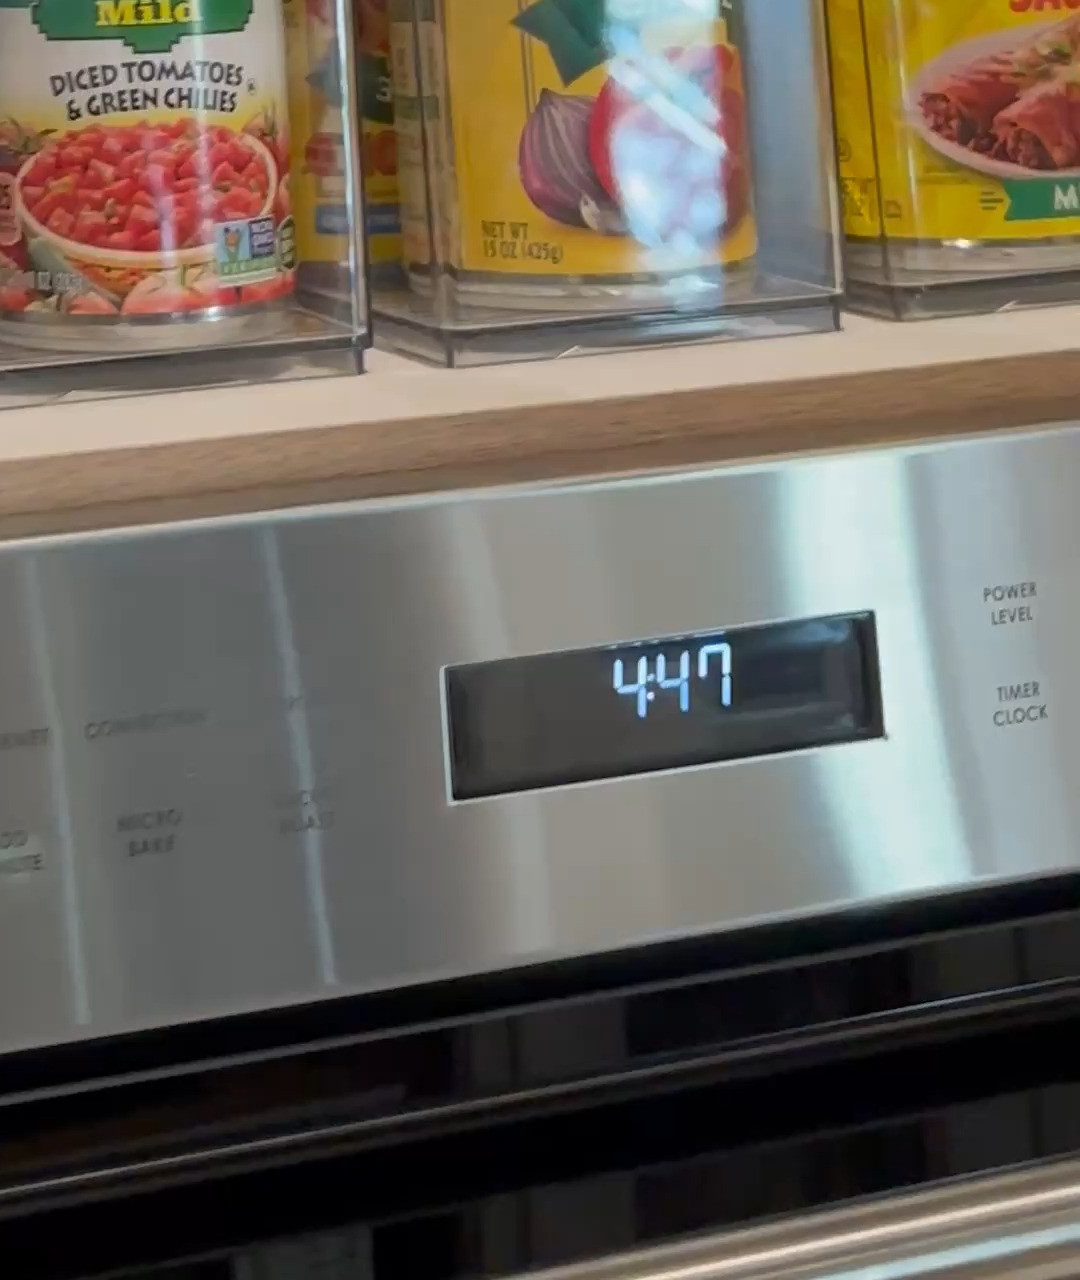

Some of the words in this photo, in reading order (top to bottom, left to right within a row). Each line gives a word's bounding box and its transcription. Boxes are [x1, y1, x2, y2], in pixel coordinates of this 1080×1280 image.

[49, 63, 119, 98] DICED
[121, 59, 244, 90] TOMATOES
[65, 99, 83, 122] &
[86, 87, 159, 119] GREEN
[163, 87, 238, 114] CHILIES
[982, 581, 1038, 603] POWER
[990, 605, 1034, 626] LEVEL
[612, 641, 733, 718] 4:47
[996, 680, 1041, 702] TIMER
[992, 704, 1049, 727] CLOCK
